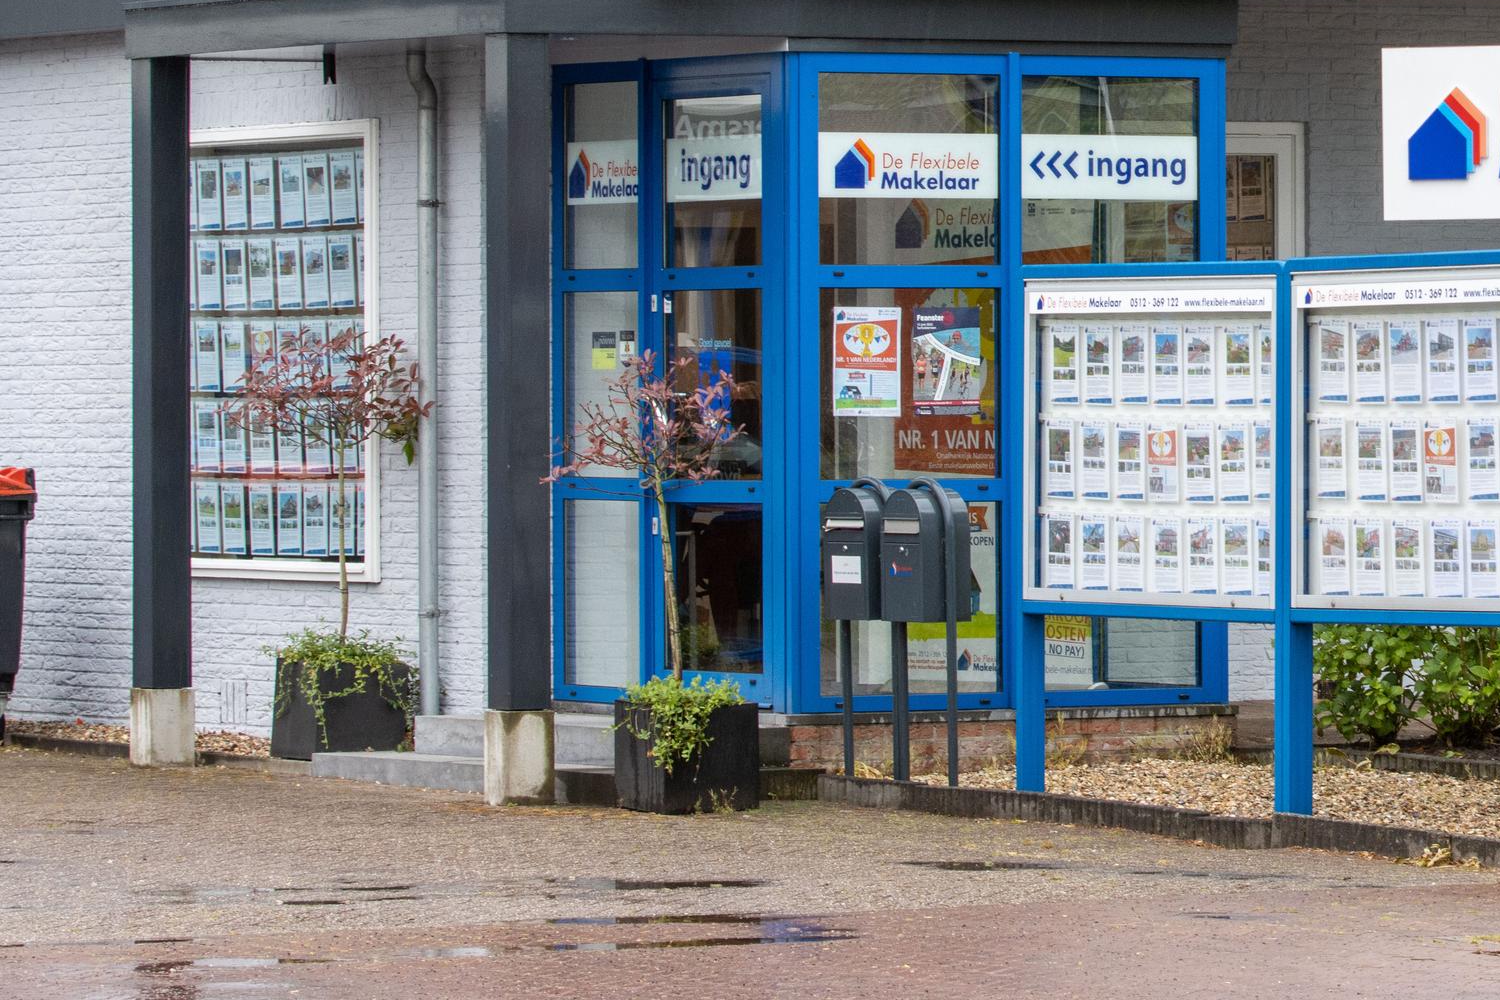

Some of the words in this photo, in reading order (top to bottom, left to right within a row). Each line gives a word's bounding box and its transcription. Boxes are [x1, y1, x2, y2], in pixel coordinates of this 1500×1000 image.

[592, 161, 604, 178] De
[607, 159, 638, 177] Flexibe
[681, 148, 751, 190] ingang
[882, 152, 903, 169] De
[910, 151, 980, 170] Flexibele
[1088, 150, 1187, 185] ingang
[881, 170, 980, 190] Makelaar
[935, 208, 954, 226] De
[1047, 296, 1057, 309] De
[1058, 295, 1088, 309] Flexibele
[1089, 297, 1122, 309] Makelaar
[1130, 297, 1147, 308] 0512
[1152, 297, 1165, 308] 369
[1167, 297, 1179, 308] 122
[1184, 296, 1265, 308] www.flexibele-makelaar.nl
[1316, 289, 1326, 303] De
[1328, 288, 1359, 302] Flexibele
[1360, 288, 1396, 302] Makelaar
[1405, 288, 1423, 300] 0512
[1429, 288, 1443, 300] 369
[1445, 287, 1458, 299] 122
[898, 429, 926, 449] NR.
[931, 429, 938, 449] 1
[944, 429, 980, 449] VAN
[1049, 643, 1063, 655] NO
